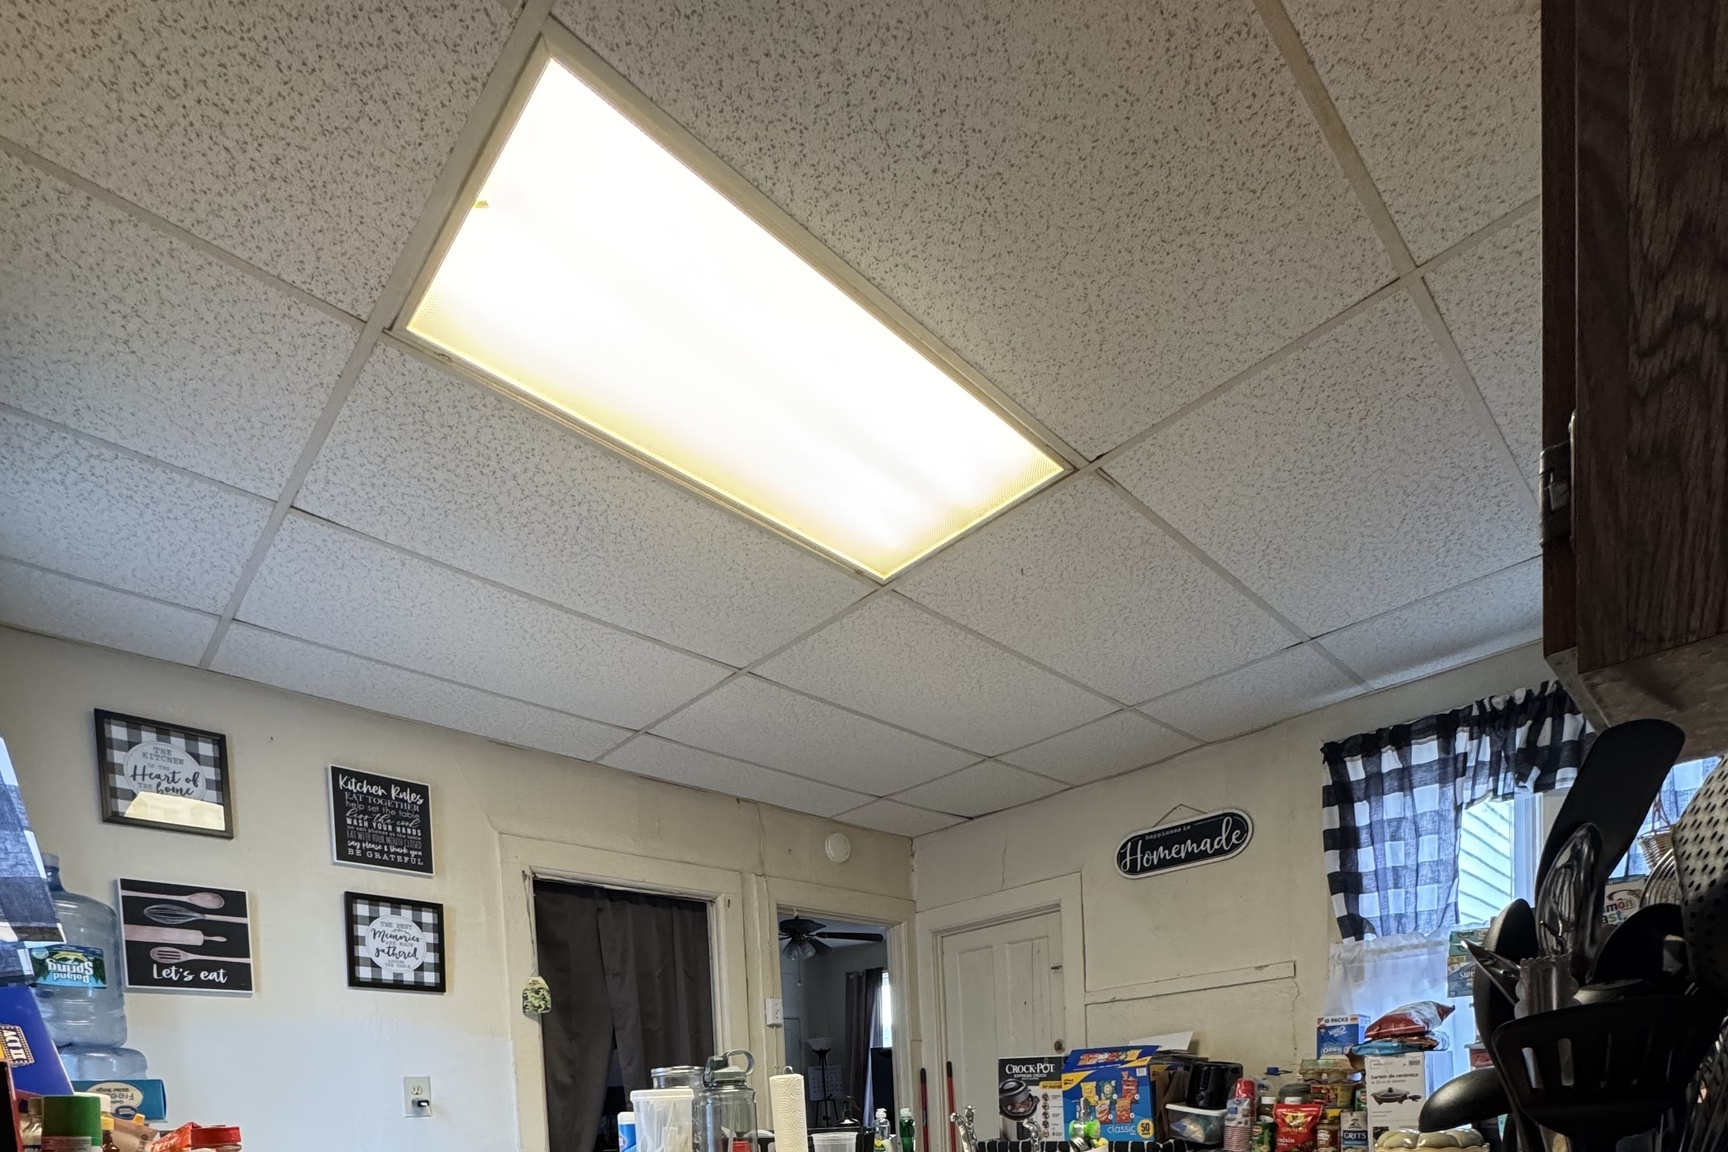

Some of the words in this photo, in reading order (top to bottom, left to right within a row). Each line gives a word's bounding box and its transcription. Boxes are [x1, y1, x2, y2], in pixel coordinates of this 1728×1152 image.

[142, 752, 184, 765] KITCHEN
[153, 746, 172, 756] THE
[130, 764, 181, 784] Heart
[185, 771, 200, 788] of
[156, 781, 194, 797] home
[339, 773, 388, 796] Kitchen
[391, 784, 424, 805] Rules
[345, 791, 364, 802] EAT
[366, 796, 419, 812] TOGETHER
[346, 800, 364, 811] help
[367, 805, 379, 813] set
[382, 806, 396, 816] the
[346, 818, 368, 827] WASH
[373, 822, 393, 831] YOUR
[396, 826, 421, 836] HANDS
[1120, 816, 1248, 872] Homemade
[348, 848, 362, 856] BE
[366, 850, 423, 865] GRATEFUL
[371, 927, 421, 943] Memories
[374, 945, 419, 960] gathered
[45, 958, 93, 975] Spring
[152, 963, 195, 982] Let's
[200, 966, 228, 984] eat
[53, 973, 89, 984] Poland
[2, 1030, 22, 1047] ACT
[10, 1049, 26, 1059] II
[1107, 1125, 1136, 1134] classic
[1141, 1123, 1150, 1132] 50
[1343, 1132, 1367, 1140] GRITS
